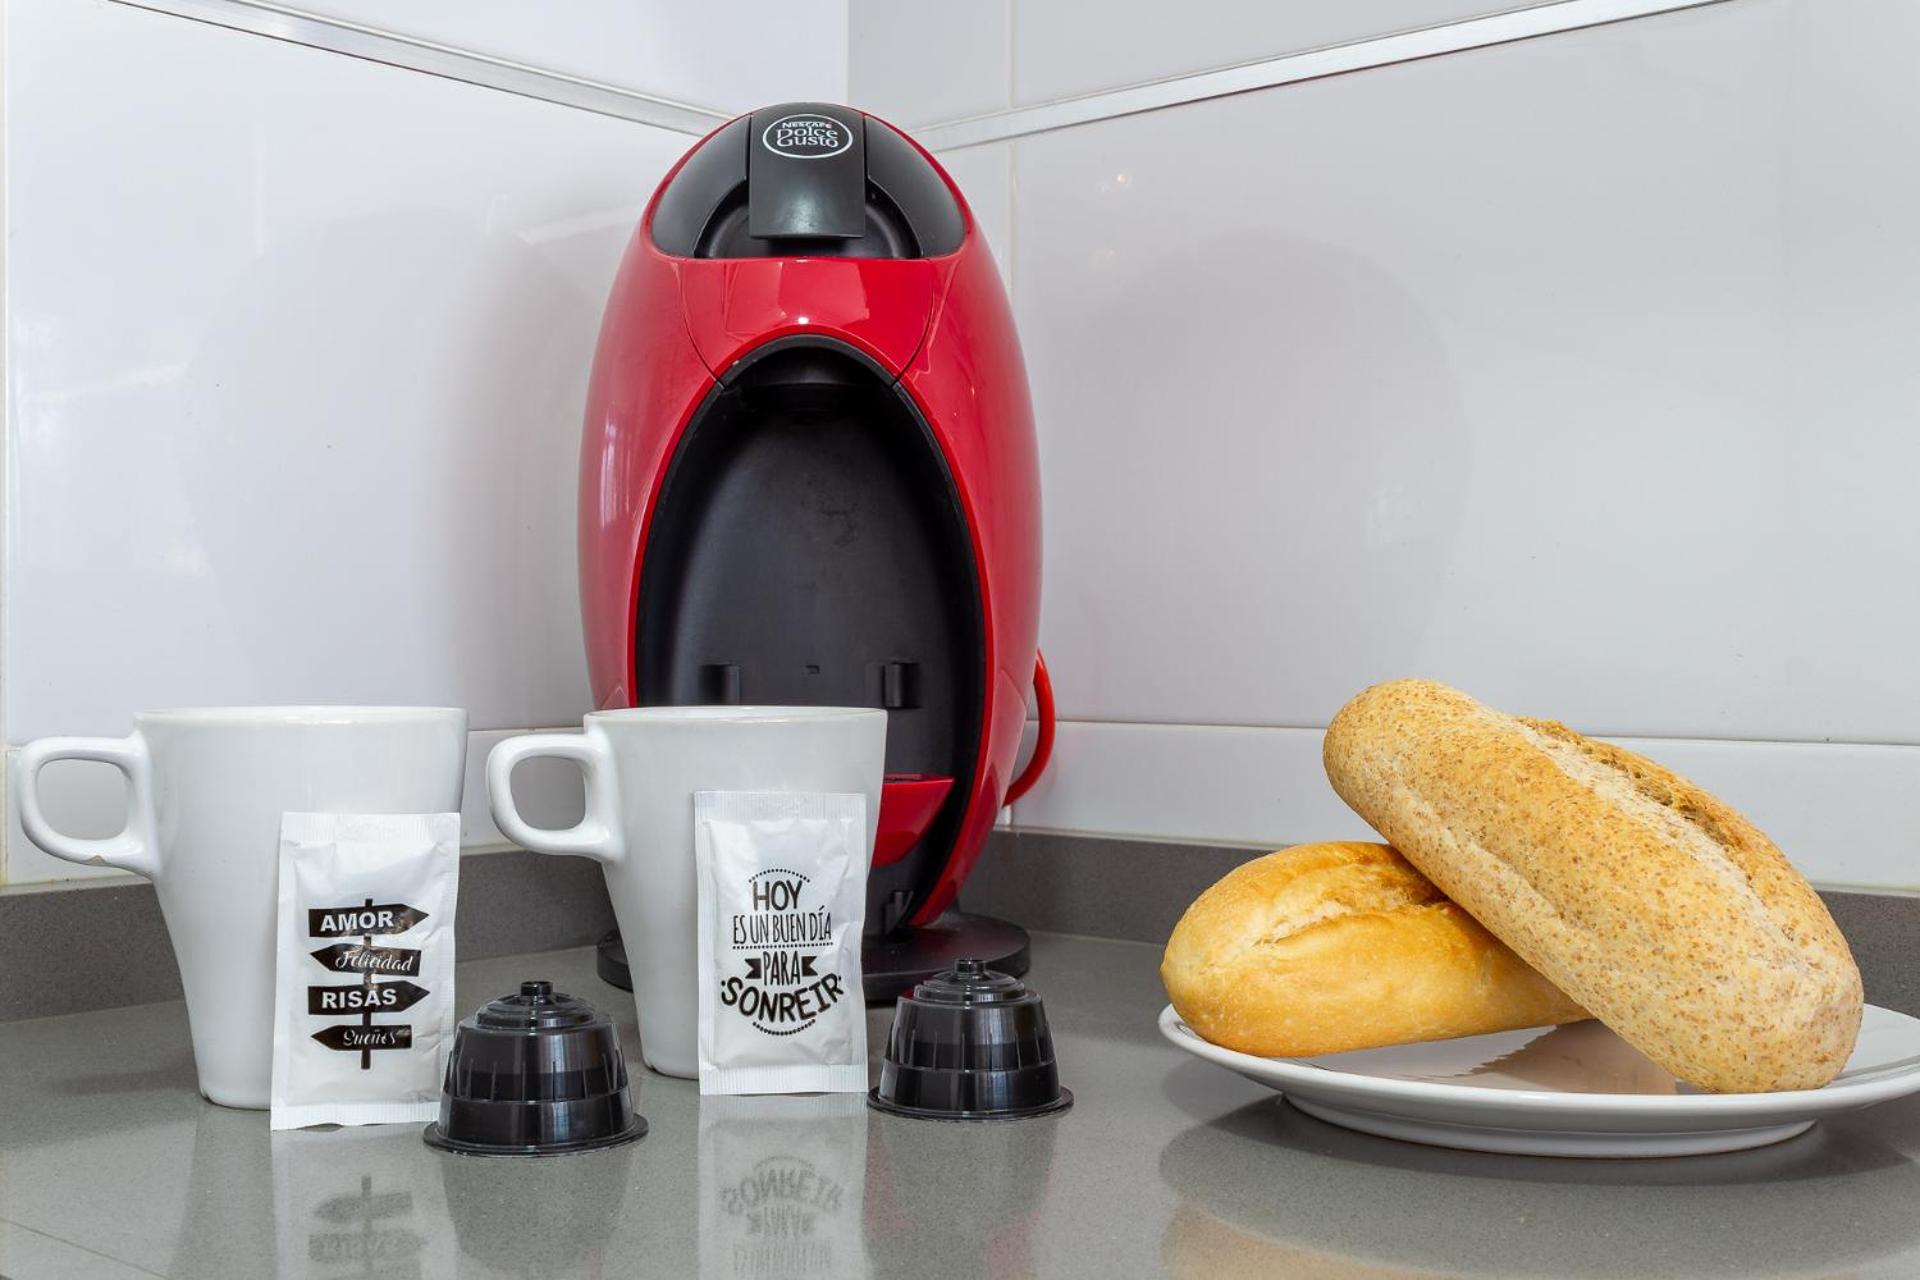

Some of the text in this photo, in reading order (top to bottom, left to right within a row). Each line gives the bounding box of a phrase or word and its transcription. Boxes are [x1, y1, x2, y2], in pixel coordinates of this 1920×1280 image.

[776, 137, 838, 148] Gusto
[777, 127, 838, 139] Dolce
[752, 880, 803, 911] HOY
[320, 910, 394, 932] AMOR
[733, 905, 832, 944] ES UN BUEN DÍA
[335, 950, 413, 972] Felicidad
[763, 950, 800, 986] PARA
[321, 988, 397, 1009] RISAS
[721, 973, 844, 1023] SONREIR
